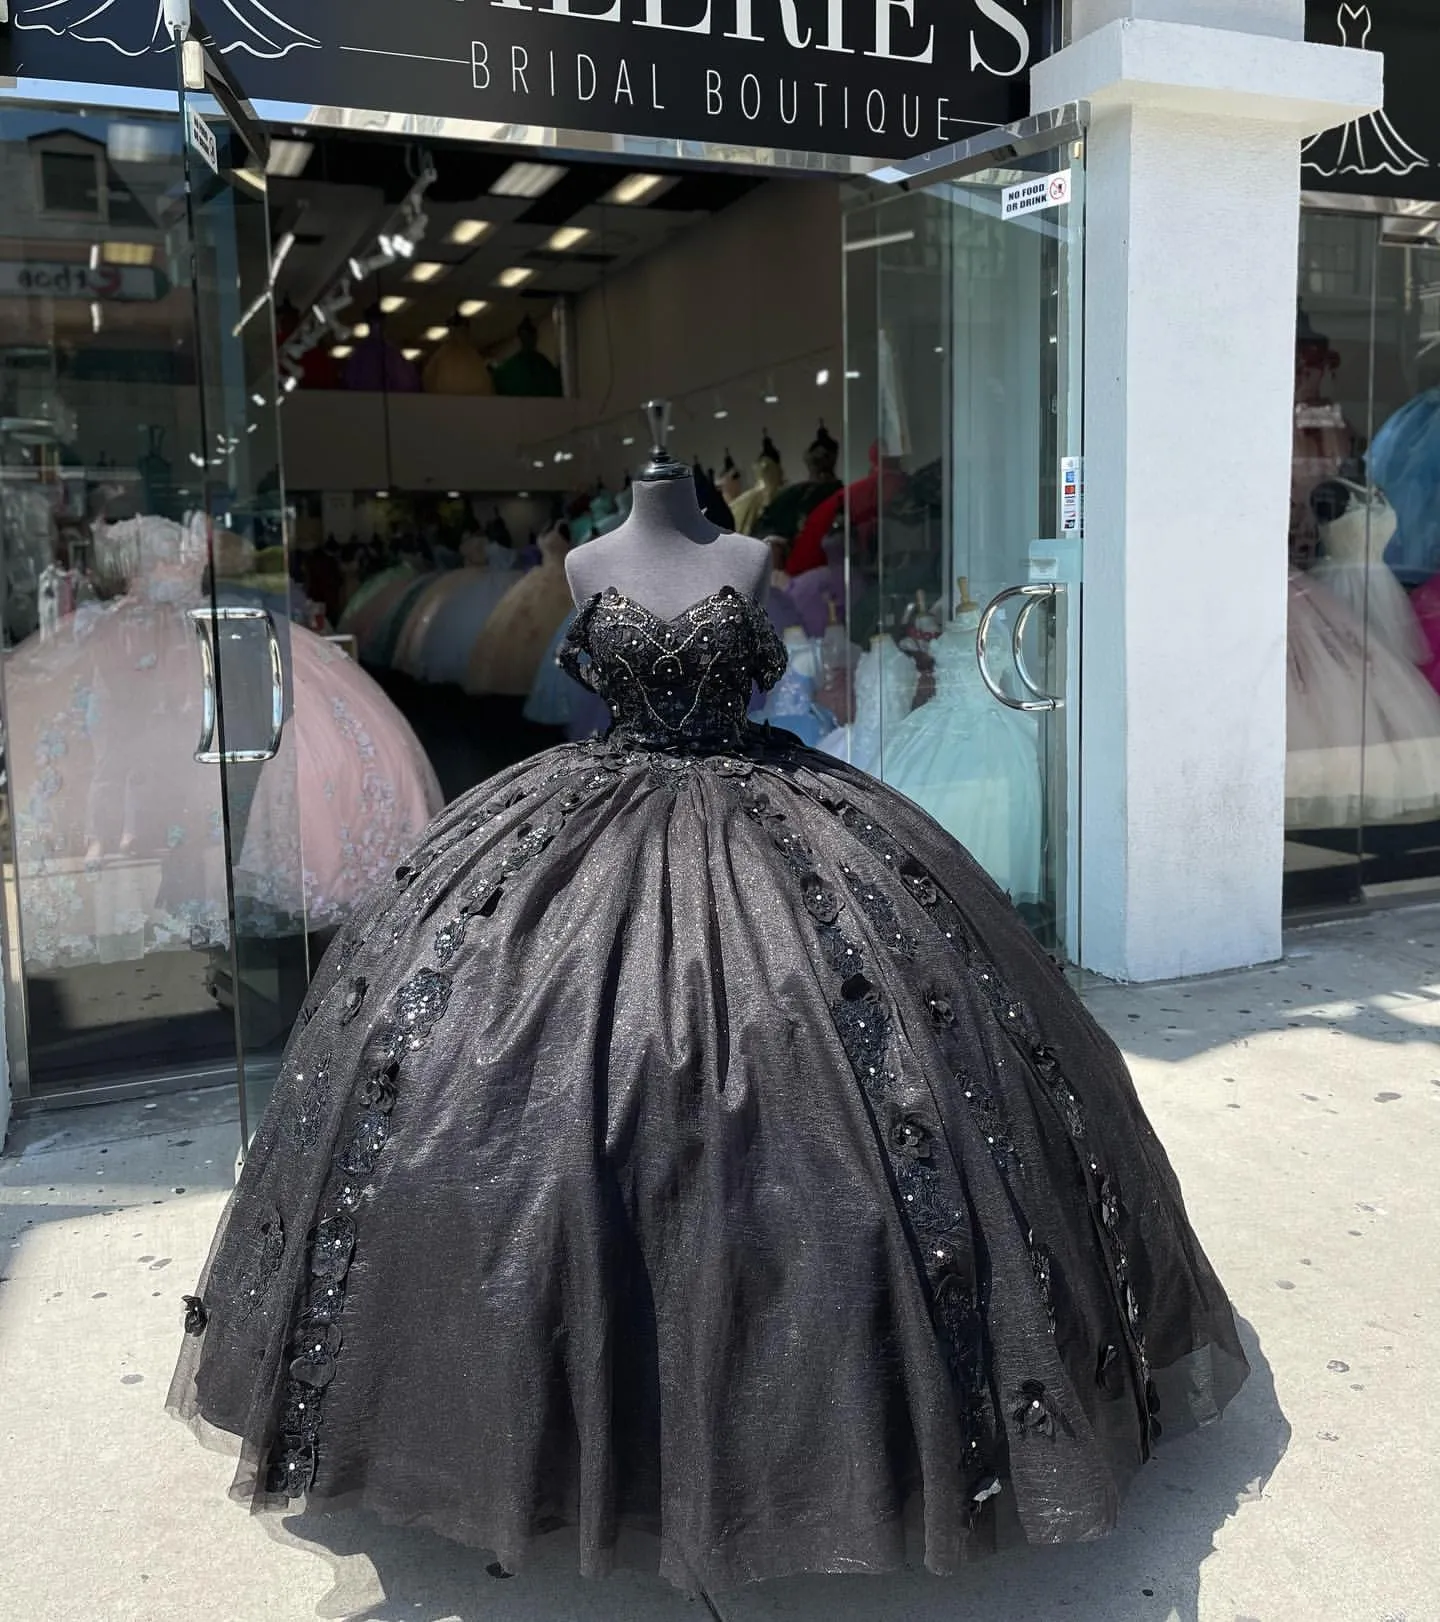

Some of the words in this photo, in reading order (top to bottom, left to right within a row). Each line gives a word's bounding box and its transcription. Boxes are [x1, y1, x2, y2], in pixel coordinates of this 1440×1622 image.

[471, 40, 665, 110] BRIDAL
[706, 69, 950, 140] BOUTIQUE
[1008, 191, 1020, 201] NO
[1022, 183, 1045, 197] FOOD
[1006, 203, 1019, 213] OR
[1019, 194, 1047, 209] DRINK
